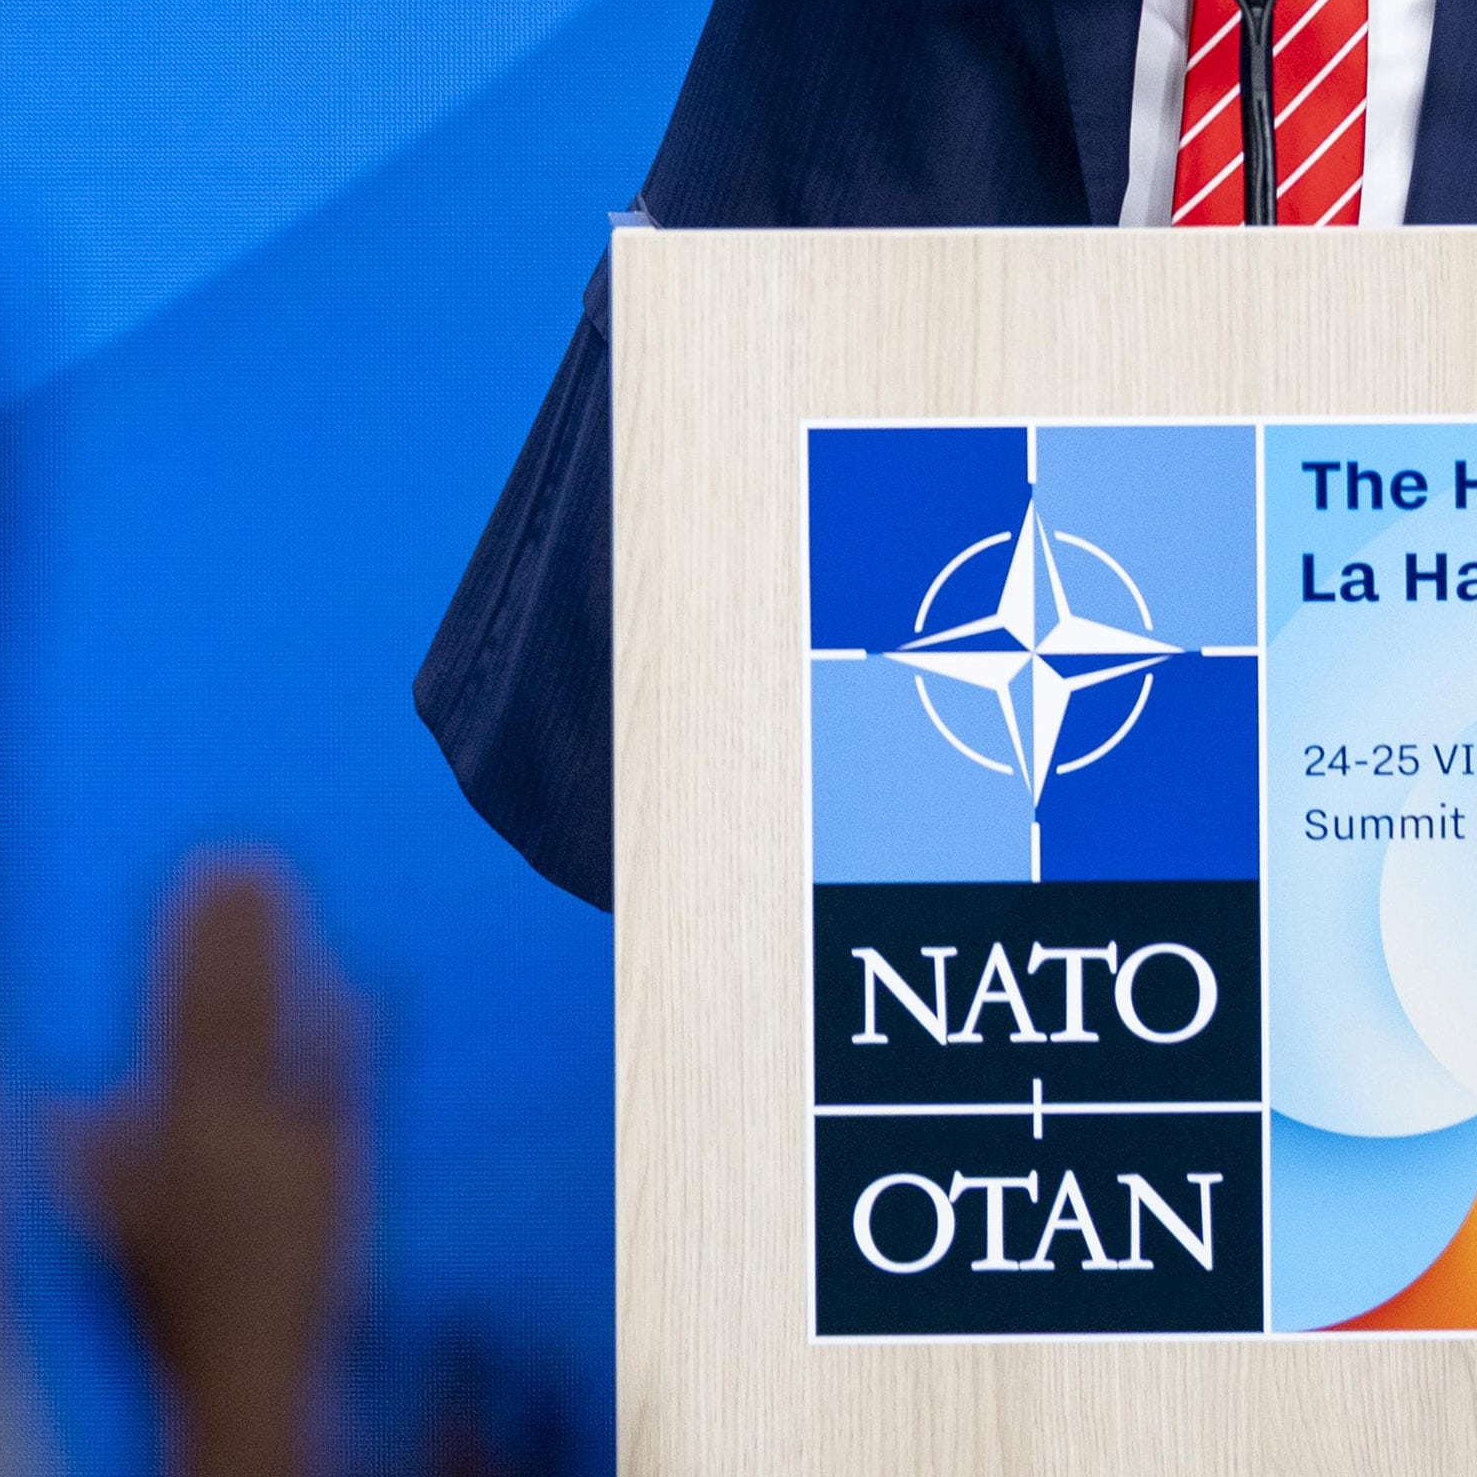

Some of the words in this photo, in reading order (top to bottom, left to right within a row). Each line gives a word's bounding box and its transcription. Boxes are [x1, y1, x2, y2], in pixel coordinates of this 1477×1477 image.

[1301, 460, 1428, 511] The
[1302, 552, 1379, 603] La
[1304, 744, 1420, 776] 24-25
[1433, 744, 1474, 775] VI
[1304, 802, 1466, 840] Summit
[851, 940, 1218, 1046] NATO
[852, 1169, 1224, 1274] OTAN
